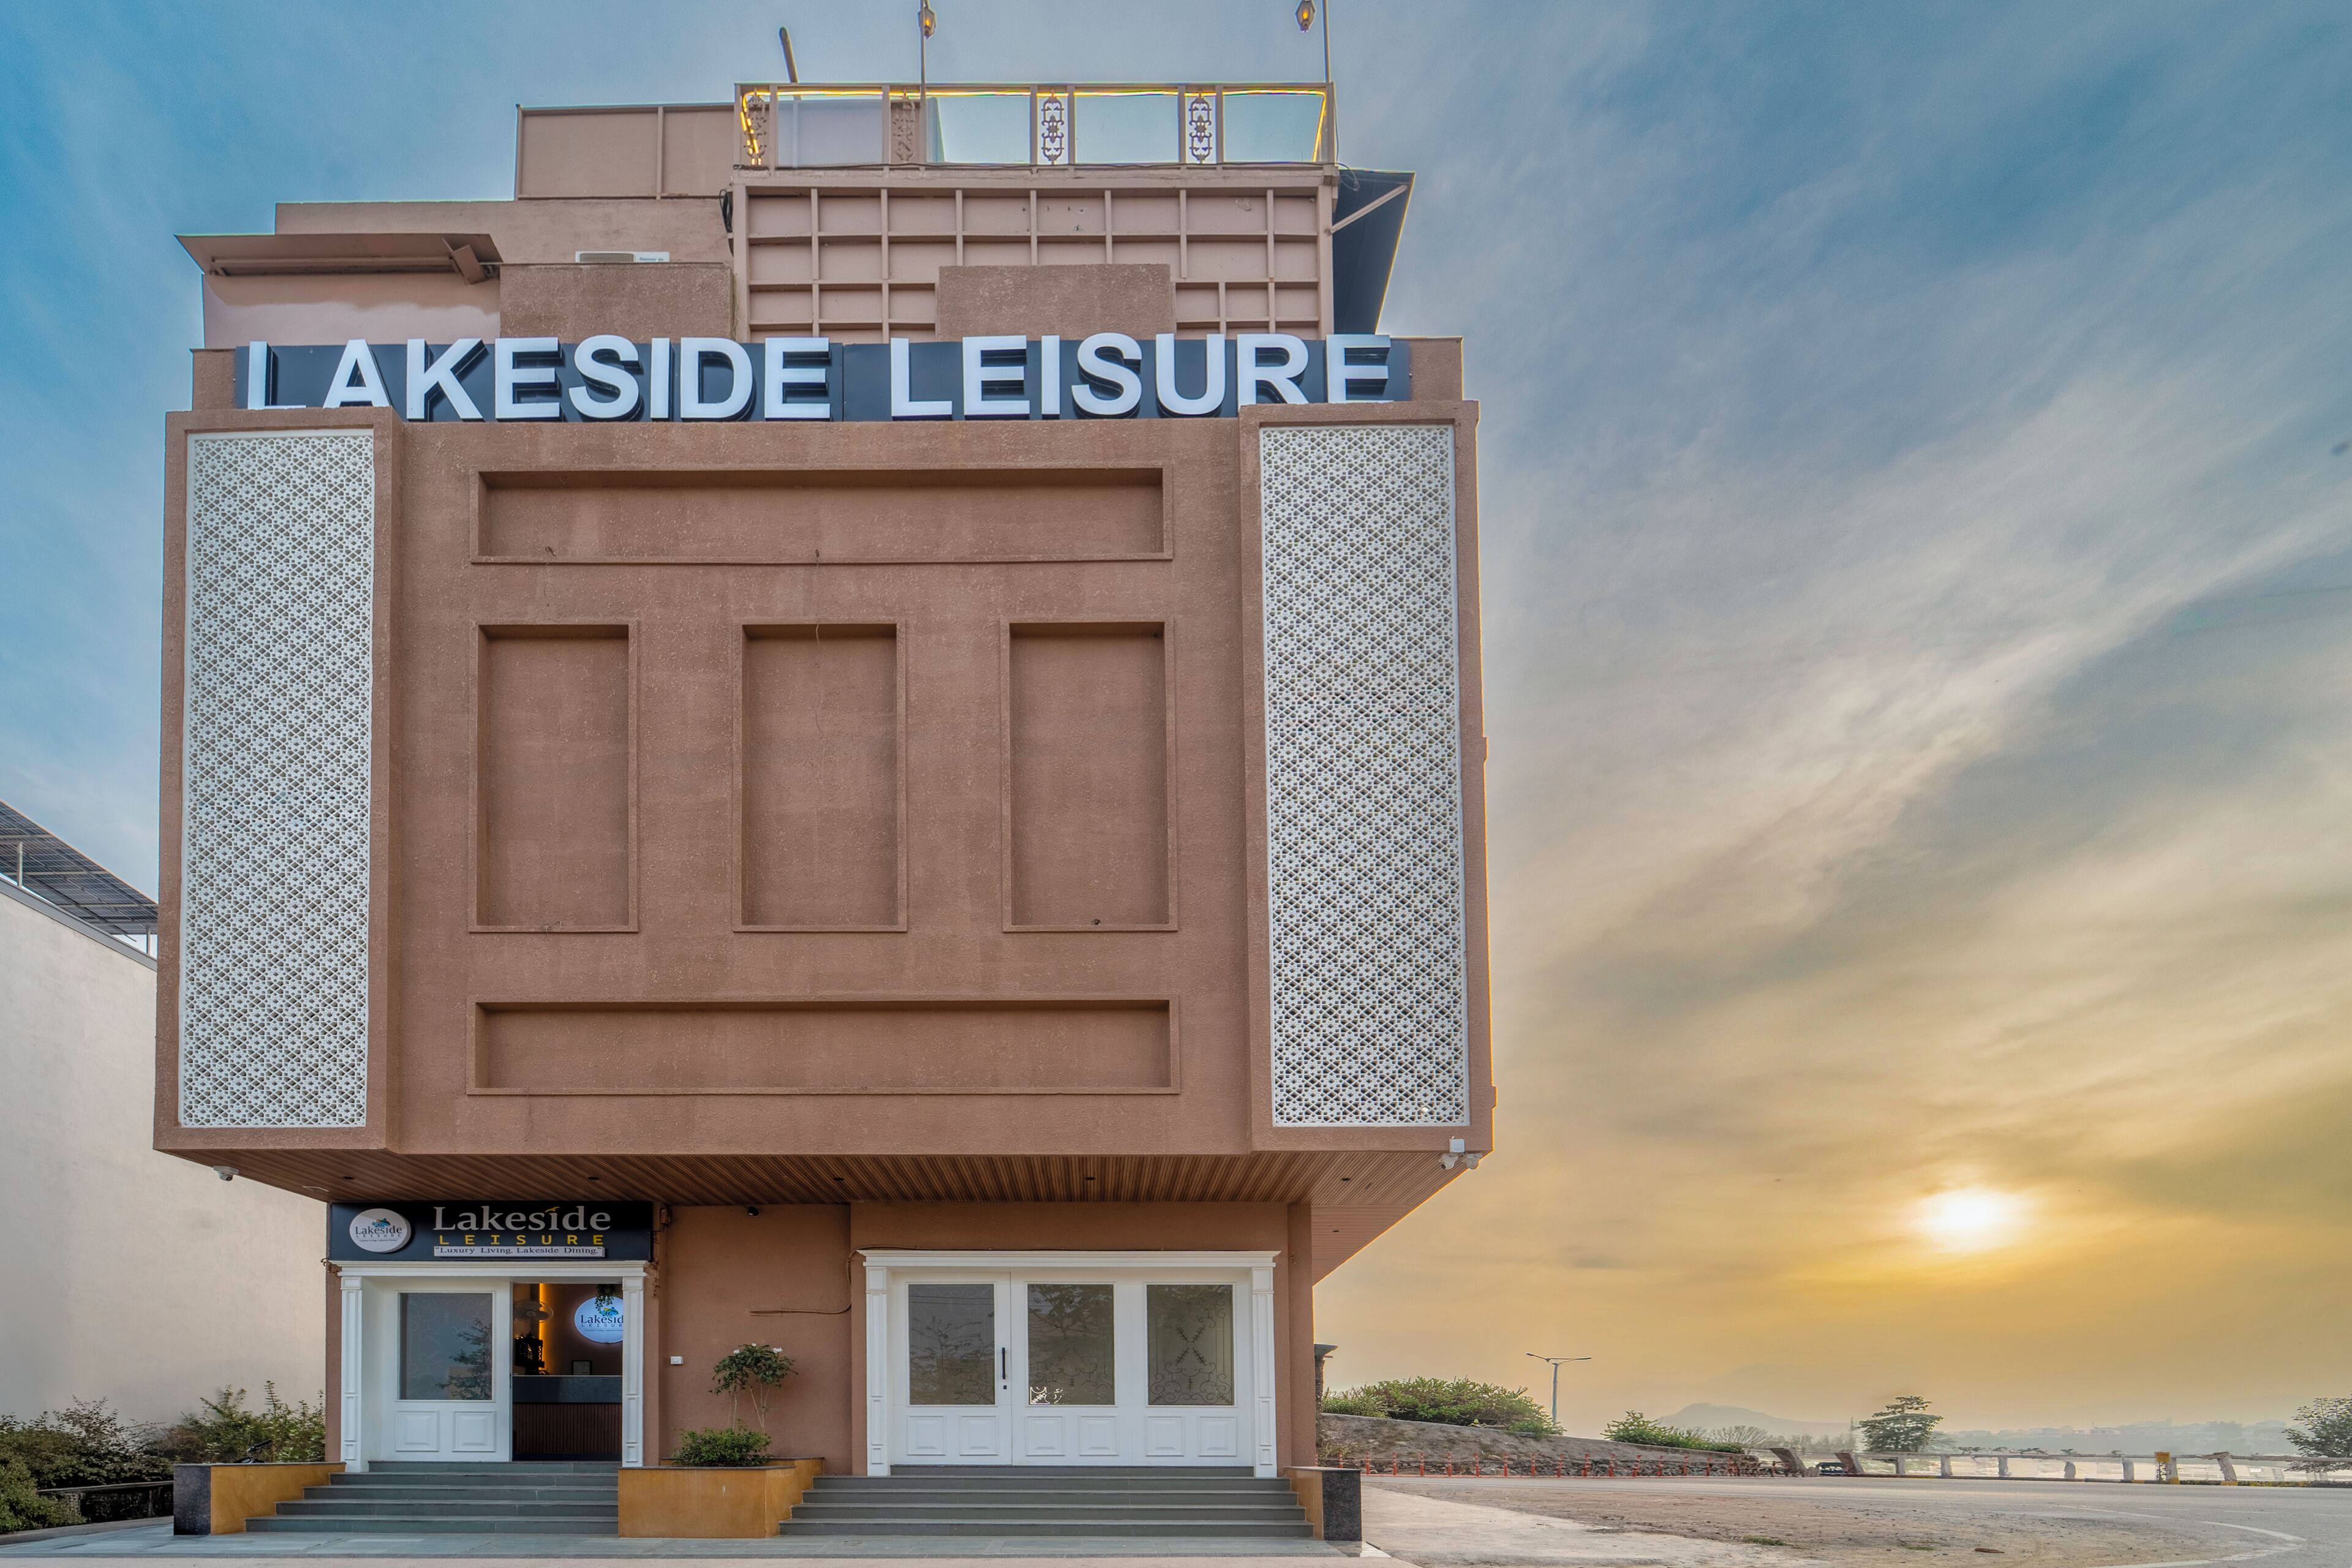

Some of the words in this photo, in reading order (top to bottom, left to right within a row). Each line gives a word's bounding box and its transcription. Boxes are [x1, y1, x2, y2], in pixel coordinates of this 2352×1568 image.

[247, 334, 831, 420] LAKESIDE
[890, 333, 1395, 418] LEISURE
[433, 1205, 611, 1231] Lakeside
[355, 1226, 402, 1235] Lakeside
[439, 1234, 604, 1245] LEISURE
[581, 1314, 624, 1324] Lakesid
